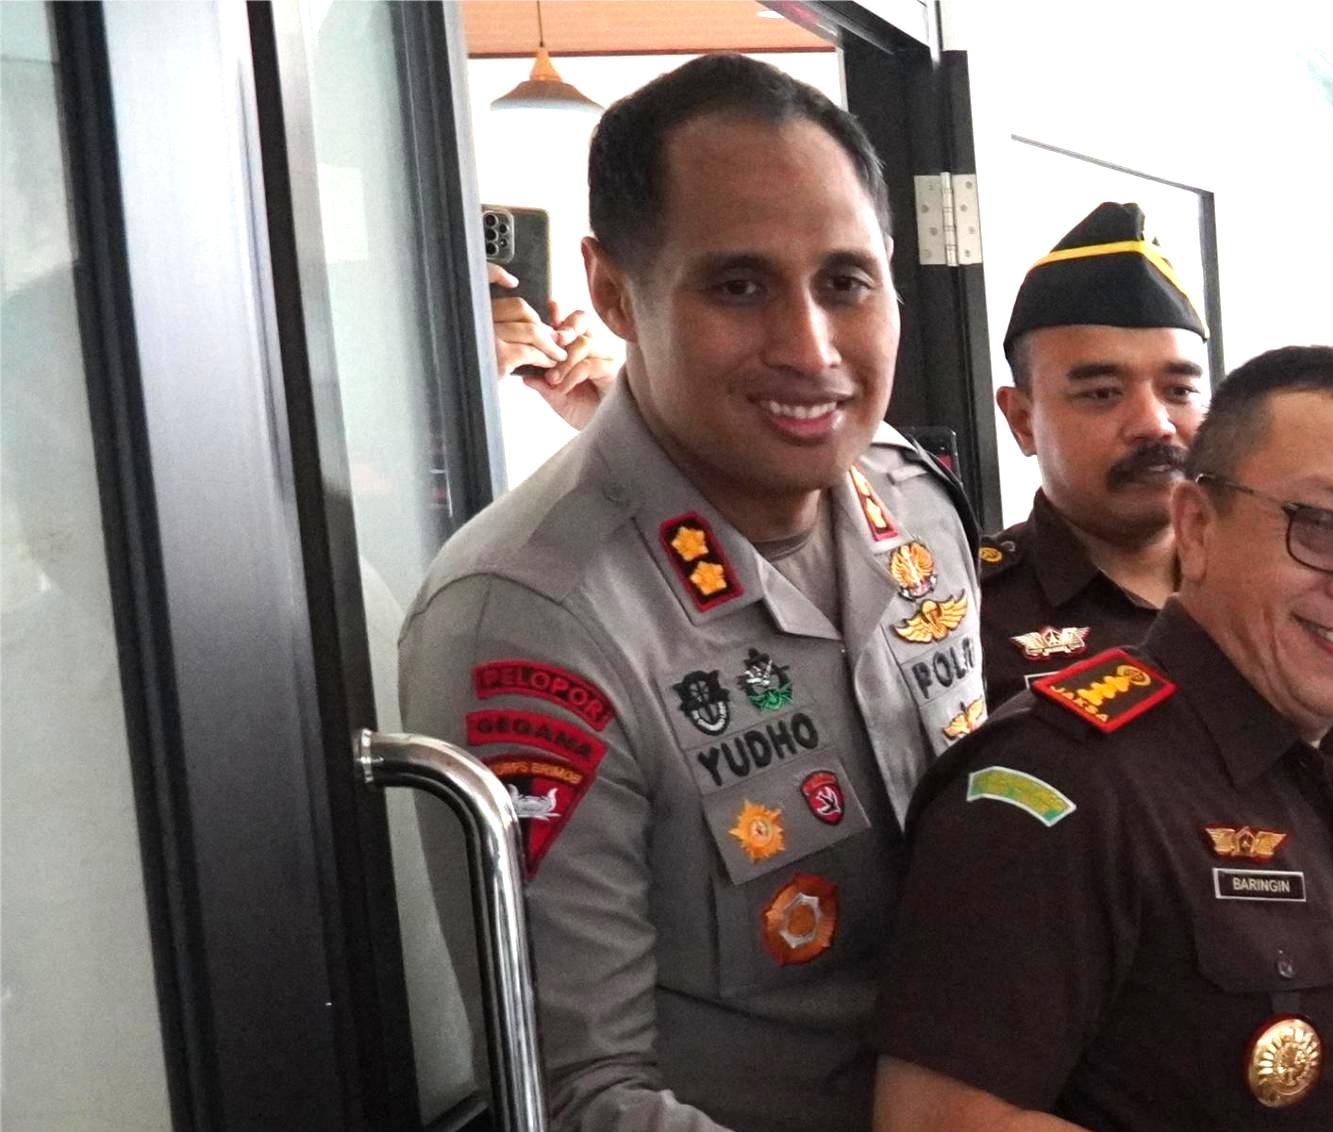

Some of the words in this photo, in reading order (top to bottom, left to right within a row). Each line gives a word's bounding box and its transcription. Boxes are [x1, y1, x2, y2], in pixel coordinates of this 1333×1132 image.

[483, 667, 608, 719] PELOPOR
[698, 712, 819, 787] YUDHO
[491, 760, 528, 777] ORPS
[1232, 877, 1290, 893] BARINGIN
